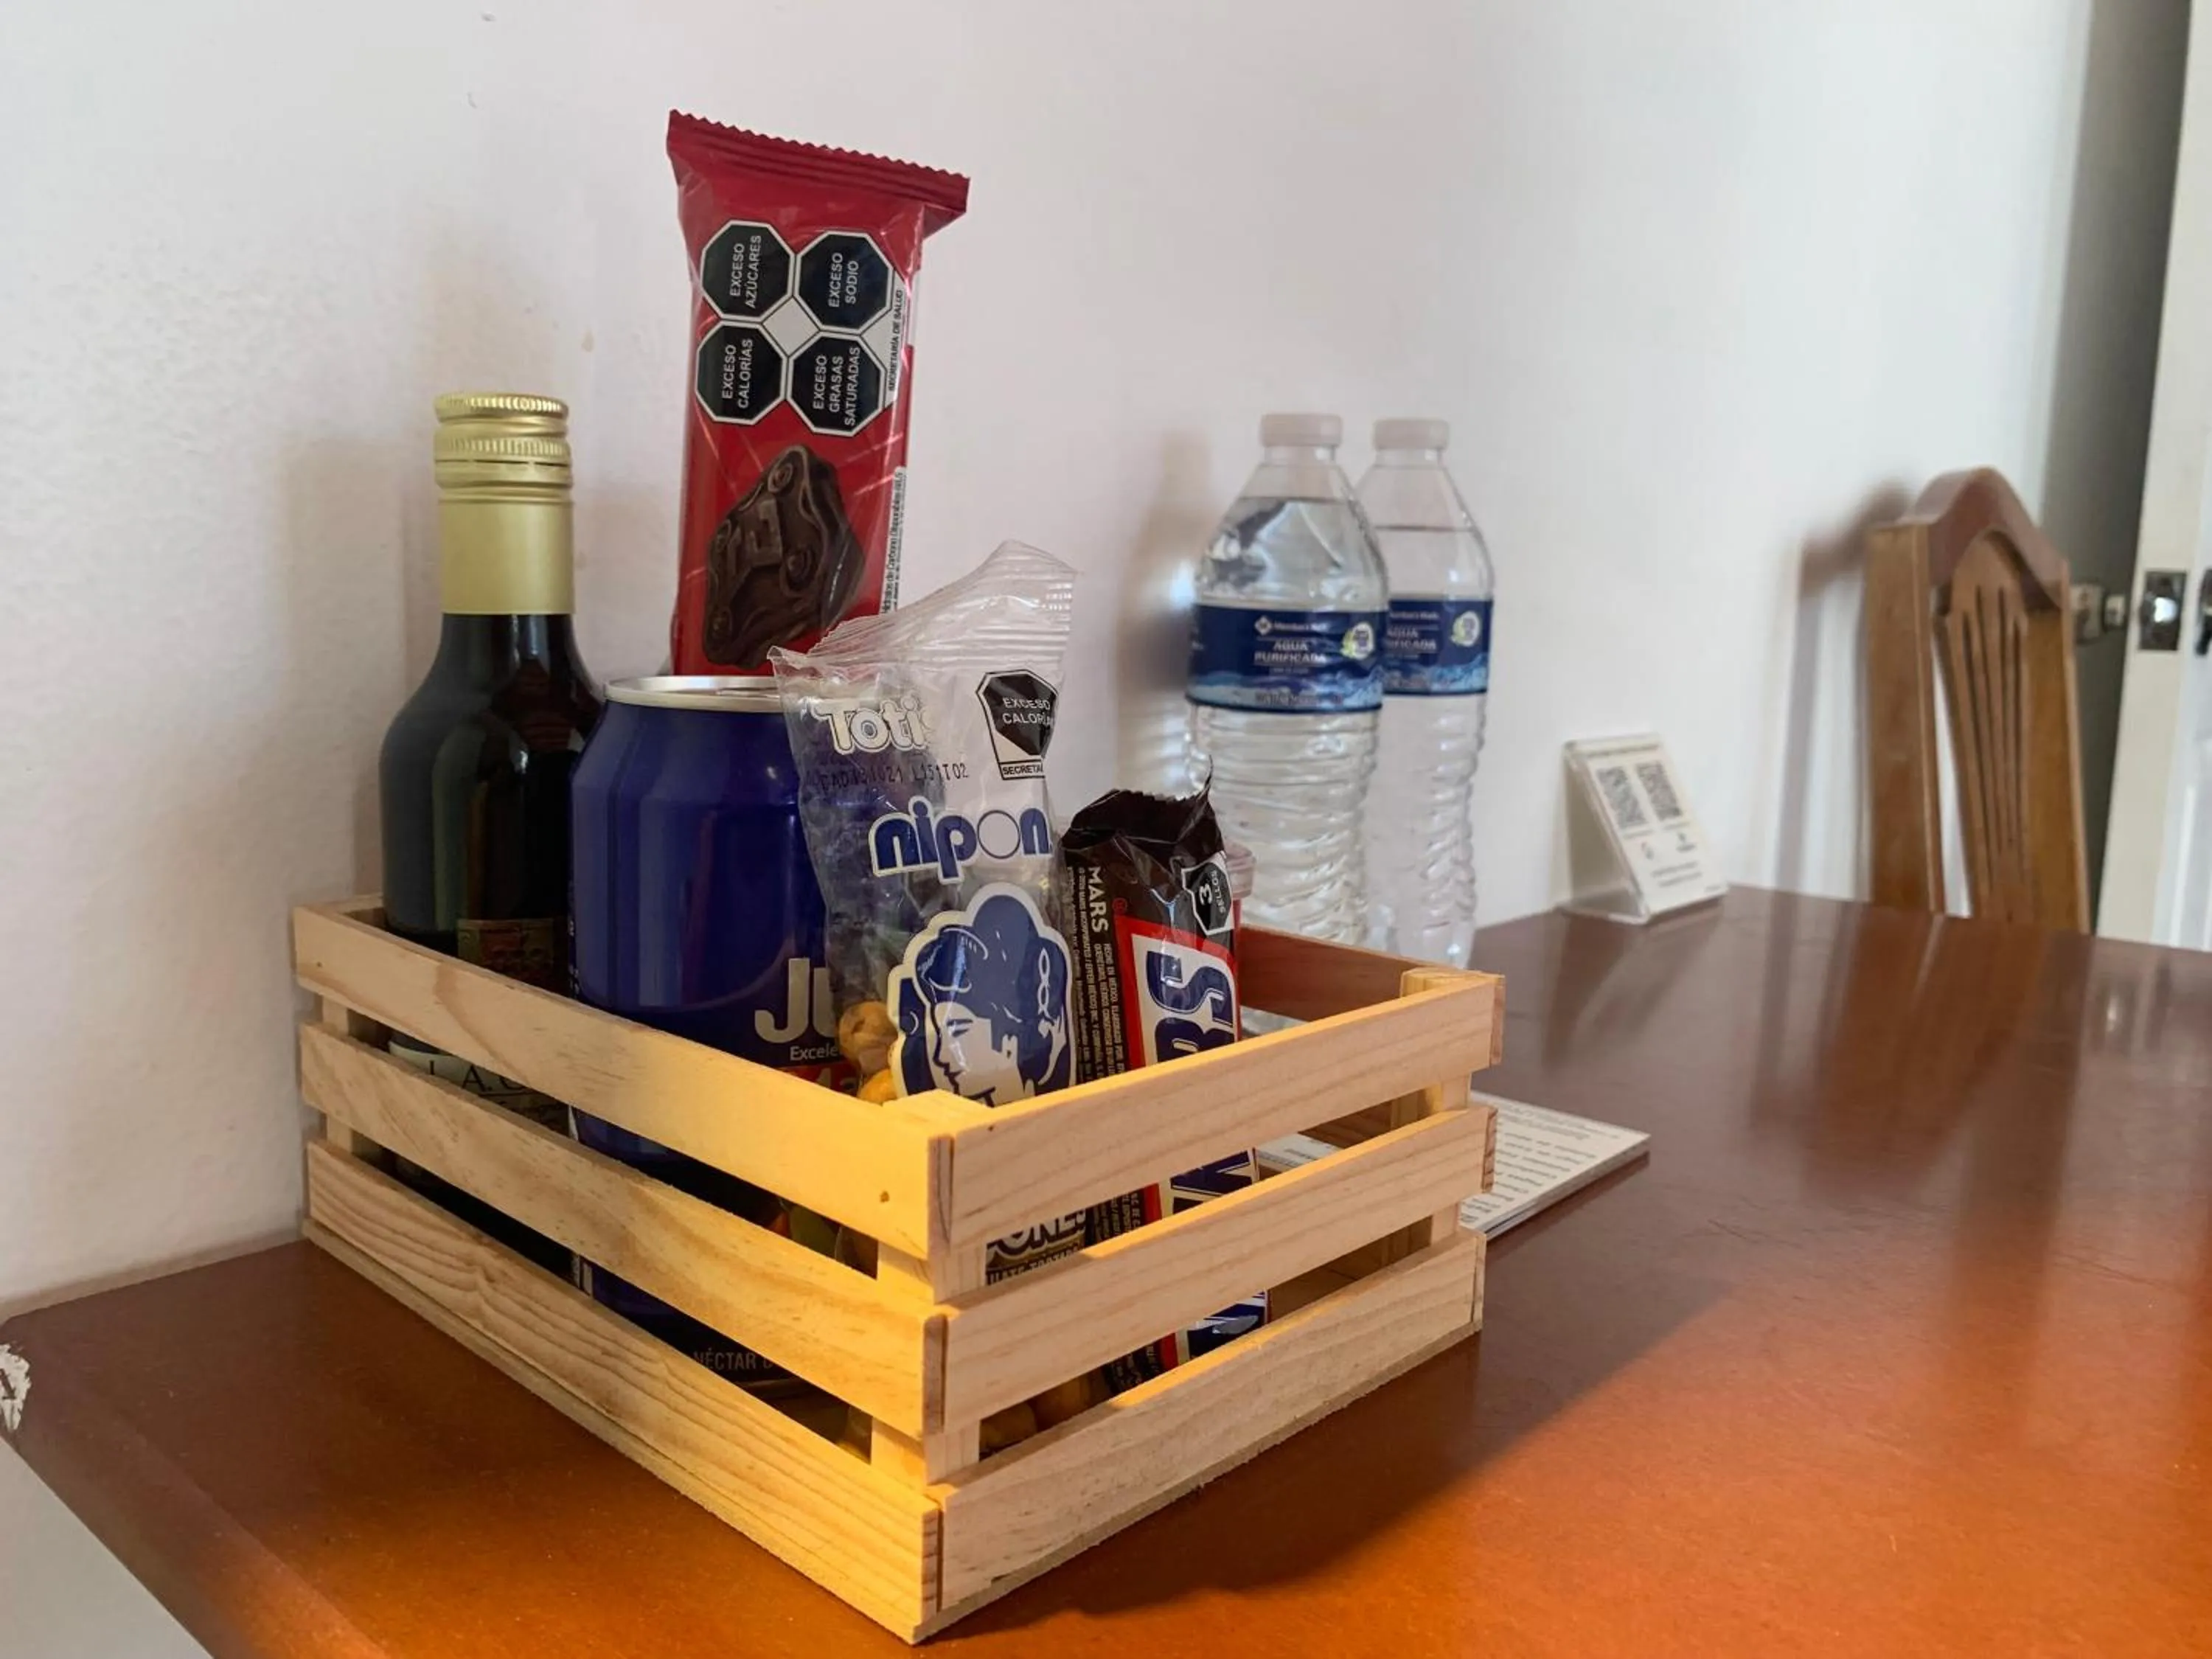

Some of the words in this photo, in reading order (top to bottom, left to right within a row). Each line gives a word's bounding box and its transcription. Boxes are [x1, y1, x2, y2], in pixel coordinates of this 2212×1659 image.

[730, 243, 745, 296] EXCESO
[745, 235, 762, 308] AZÚCARES
[828, 252, 843, 307] EXCESO
[845, 260, 859, 304] SODIO
[893, 319, 900, 335] DE
[722, 344, 737, 399] EXCESO
[738, 338, 753, 408] CALORÍAS
[813, 355, 828, 409] EXCESO
[830, 355, 844, 413] GRASAS
[844, 347, 860, 426] SATURADAS
[1254, 652, 1327, 664] PURIFICADA
[1273, 640, 1309, 651] AGUA
[1003, 697, 1051, 710] EXCESO
[1088, 866, 1108, 933] MARS
